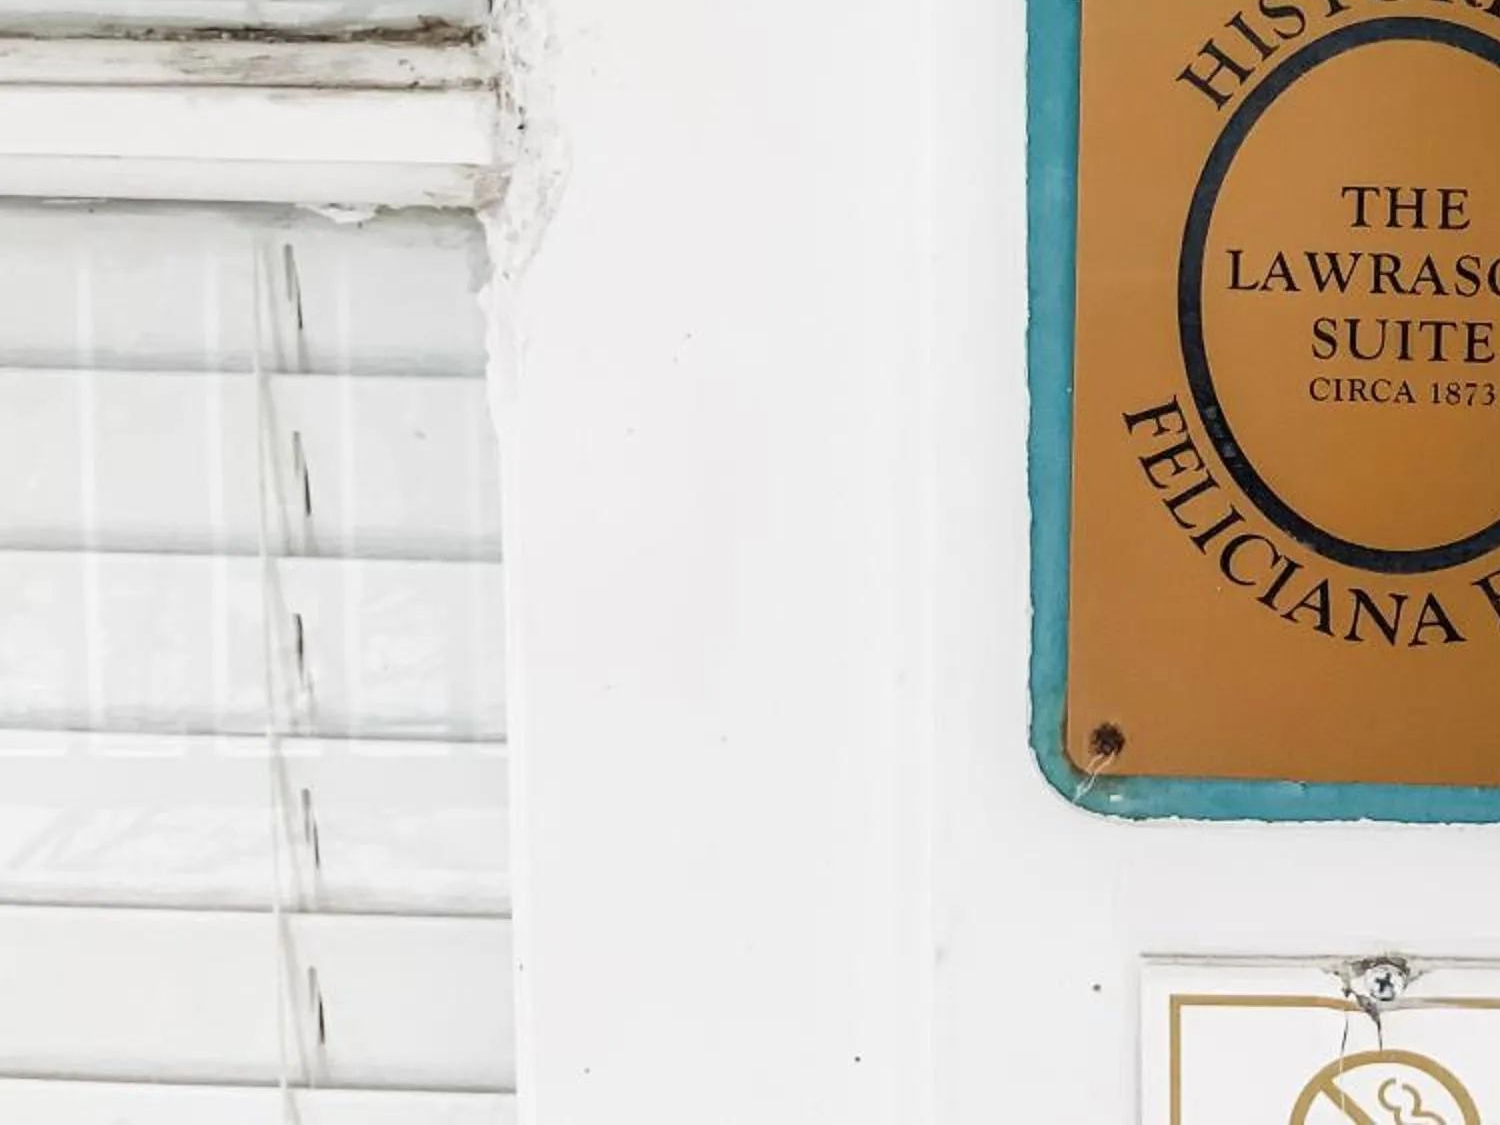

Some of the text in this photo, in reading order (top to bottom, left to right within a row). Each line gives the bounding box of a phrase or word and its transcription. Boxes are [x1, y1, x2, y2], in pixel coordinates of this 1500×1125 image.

[1341, 186, 1472, 231] THE
[1310, 317, 1497, 365] SUITE
[1308, 376, 1497, 407] CIRCA 1873
[1121, 393, 1468, 649] FELICIANA
